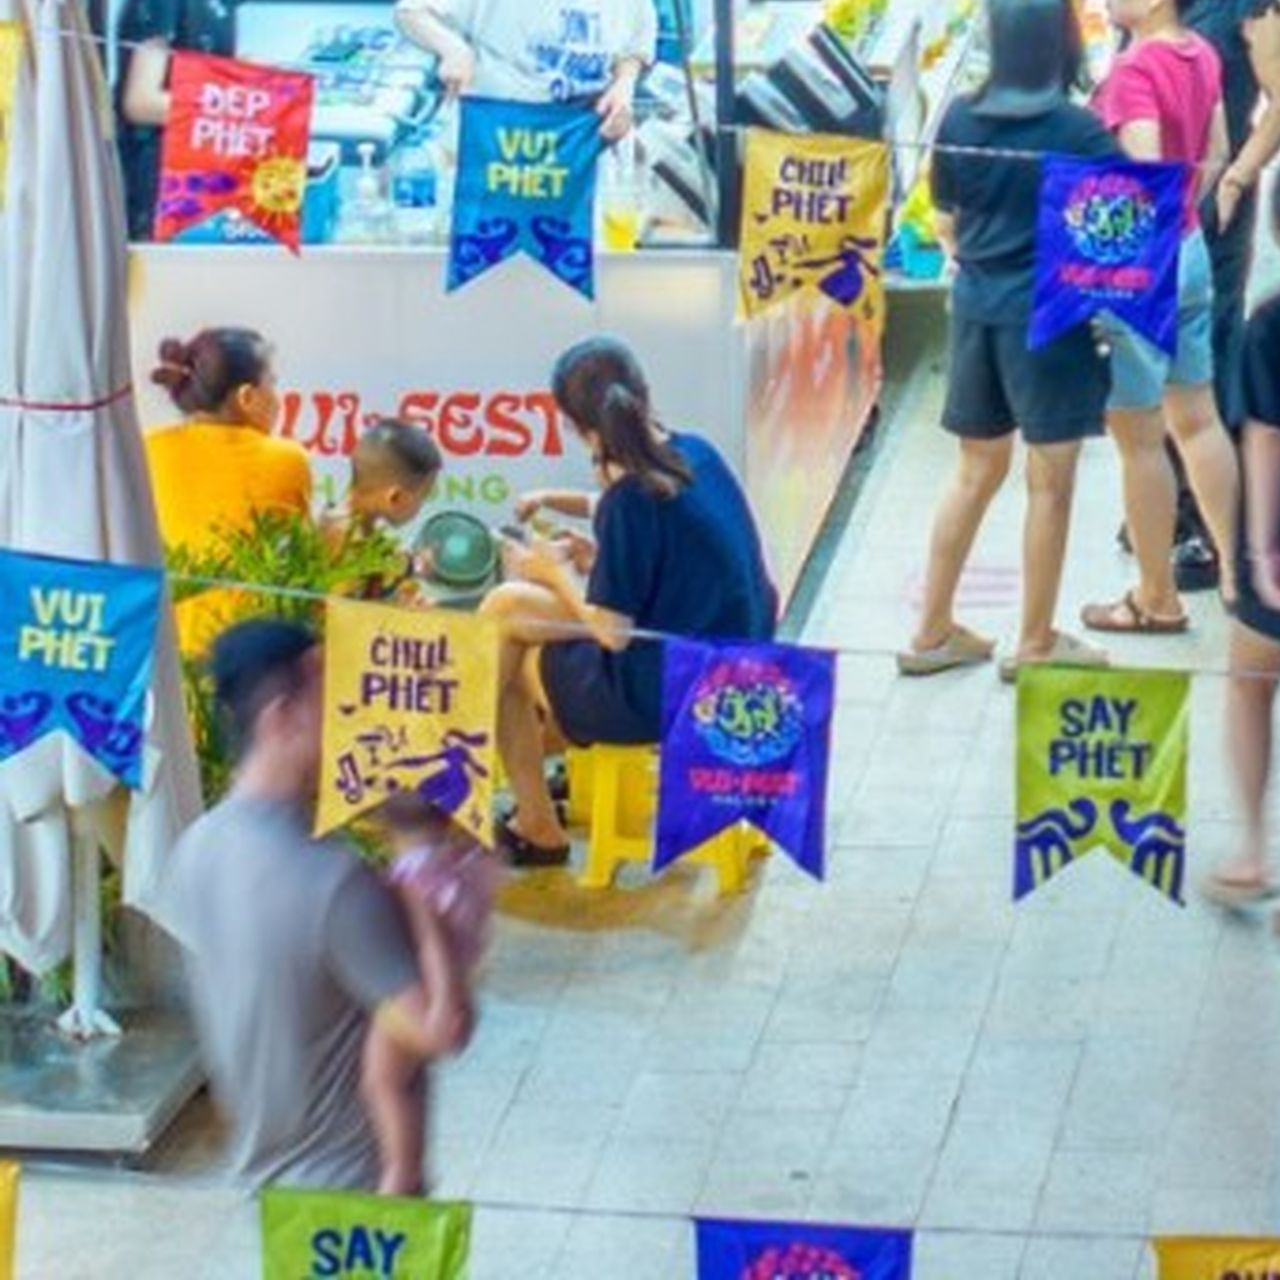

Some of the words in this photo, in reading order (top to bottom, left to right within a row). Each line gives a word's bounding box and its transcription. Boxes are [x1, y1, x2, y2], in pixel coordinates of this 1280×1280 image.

[497, 127, 559, 166] VUI
[280, 392, 359, 455] UI
[28, 587, 104, 627] VUI
[369, 634, 451, 671] CHILL
[1056, 695, 1135, 738] SAY
[311, 1227, 406, 1276] SAY
